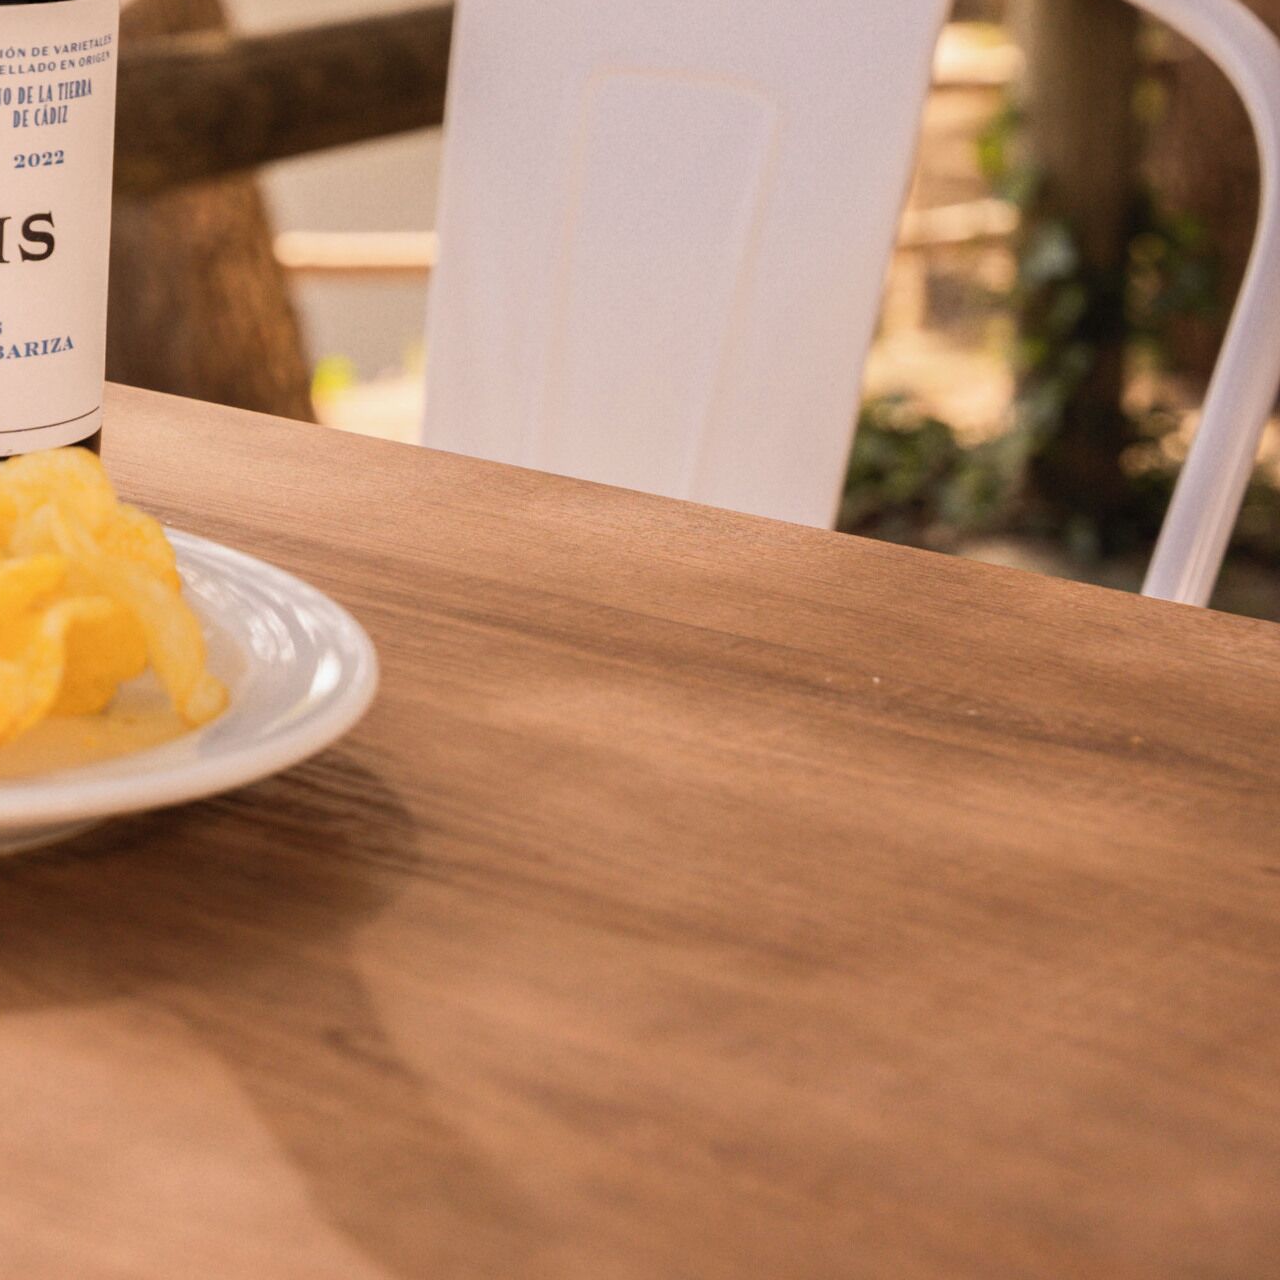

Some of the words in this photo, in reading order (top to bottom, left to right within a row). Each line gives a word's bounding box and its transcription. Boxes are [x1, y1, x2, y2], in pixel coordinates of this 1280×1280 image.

[31, 46, 49, 57] DE
[53, 34, 112, 55] VARIETALES
[60, 58, 76, 70] EN
[17, 86, 34, 104] DE
[38, 84, 53, 102] LA
[57, 78, 92, 101] TIERRA
[13, 110, 29, 128] DE
[34, 104, 68, 127] CÁDIZ
[13, 150, 65, 169] 2022
